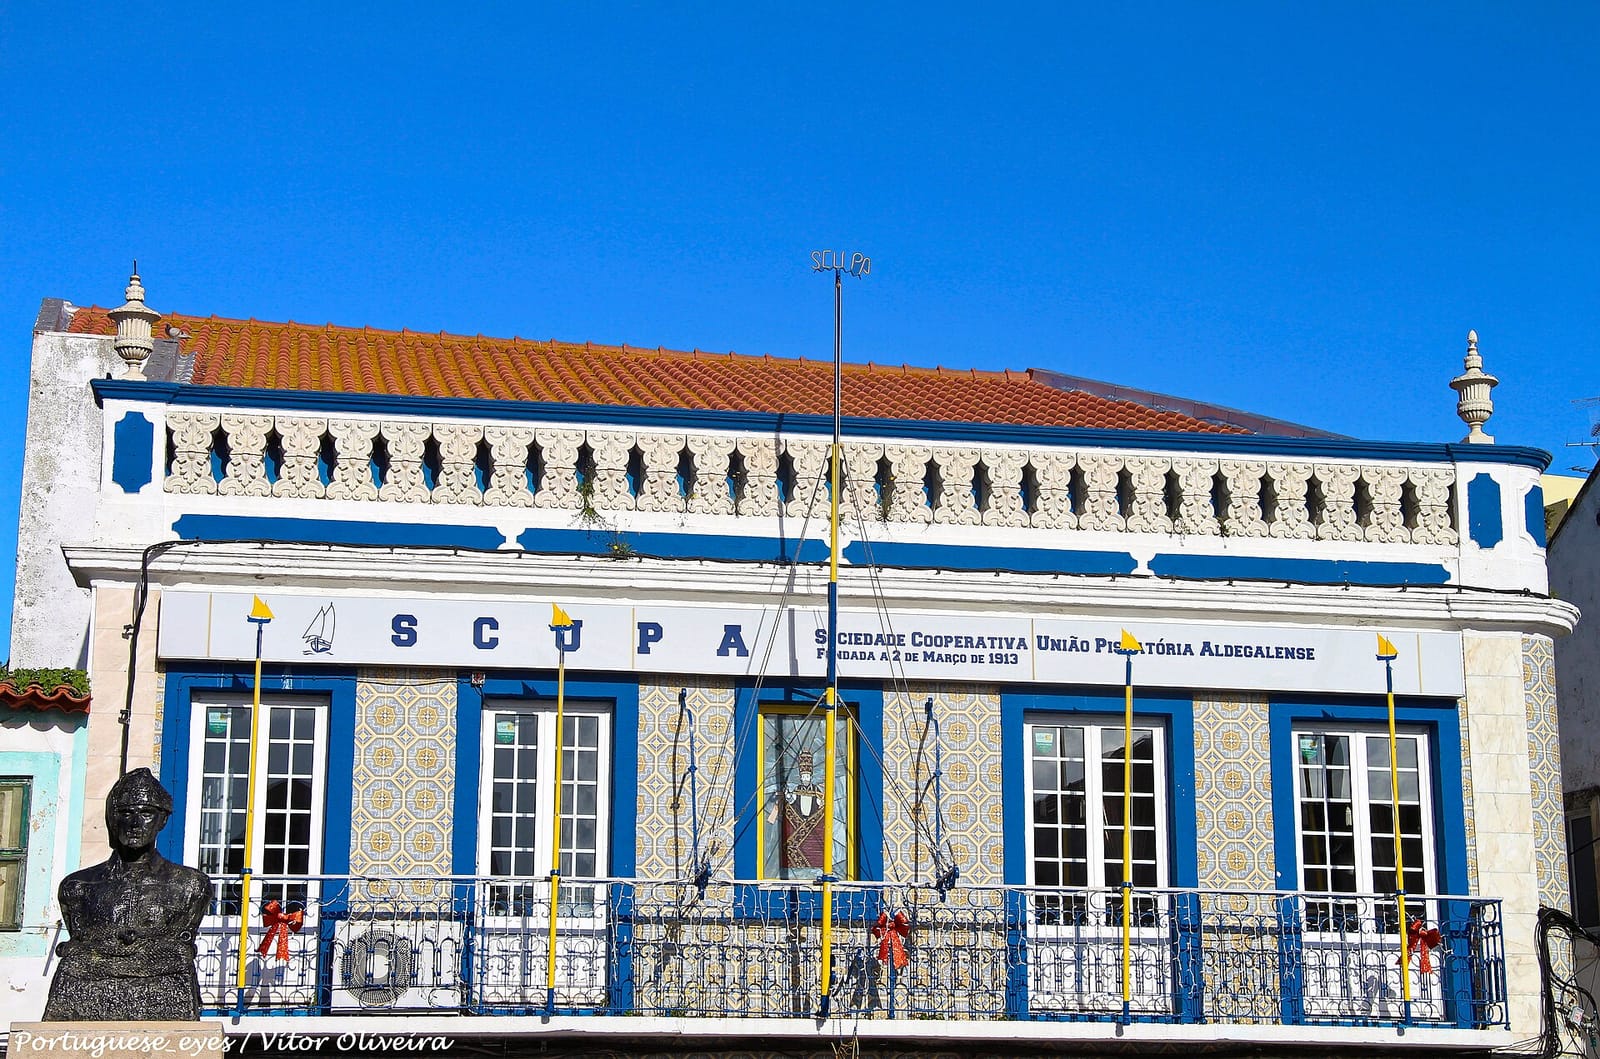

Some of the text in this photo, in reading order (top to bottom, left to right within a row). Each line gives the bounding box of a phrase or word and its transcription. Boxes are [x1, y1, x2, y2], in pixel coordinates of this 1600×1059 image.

[815, 628, 906, 647] SCIEDADE
[911, 632, 1028, 650] COOPERATIVA
[1036, 635, 1089, 653] UNIÃO
[1200, 641, 1315, 660] ALDEGALENSE
[816, 647, 1019, 666] FNDADA A 2 DE MARÇO DE 1913
